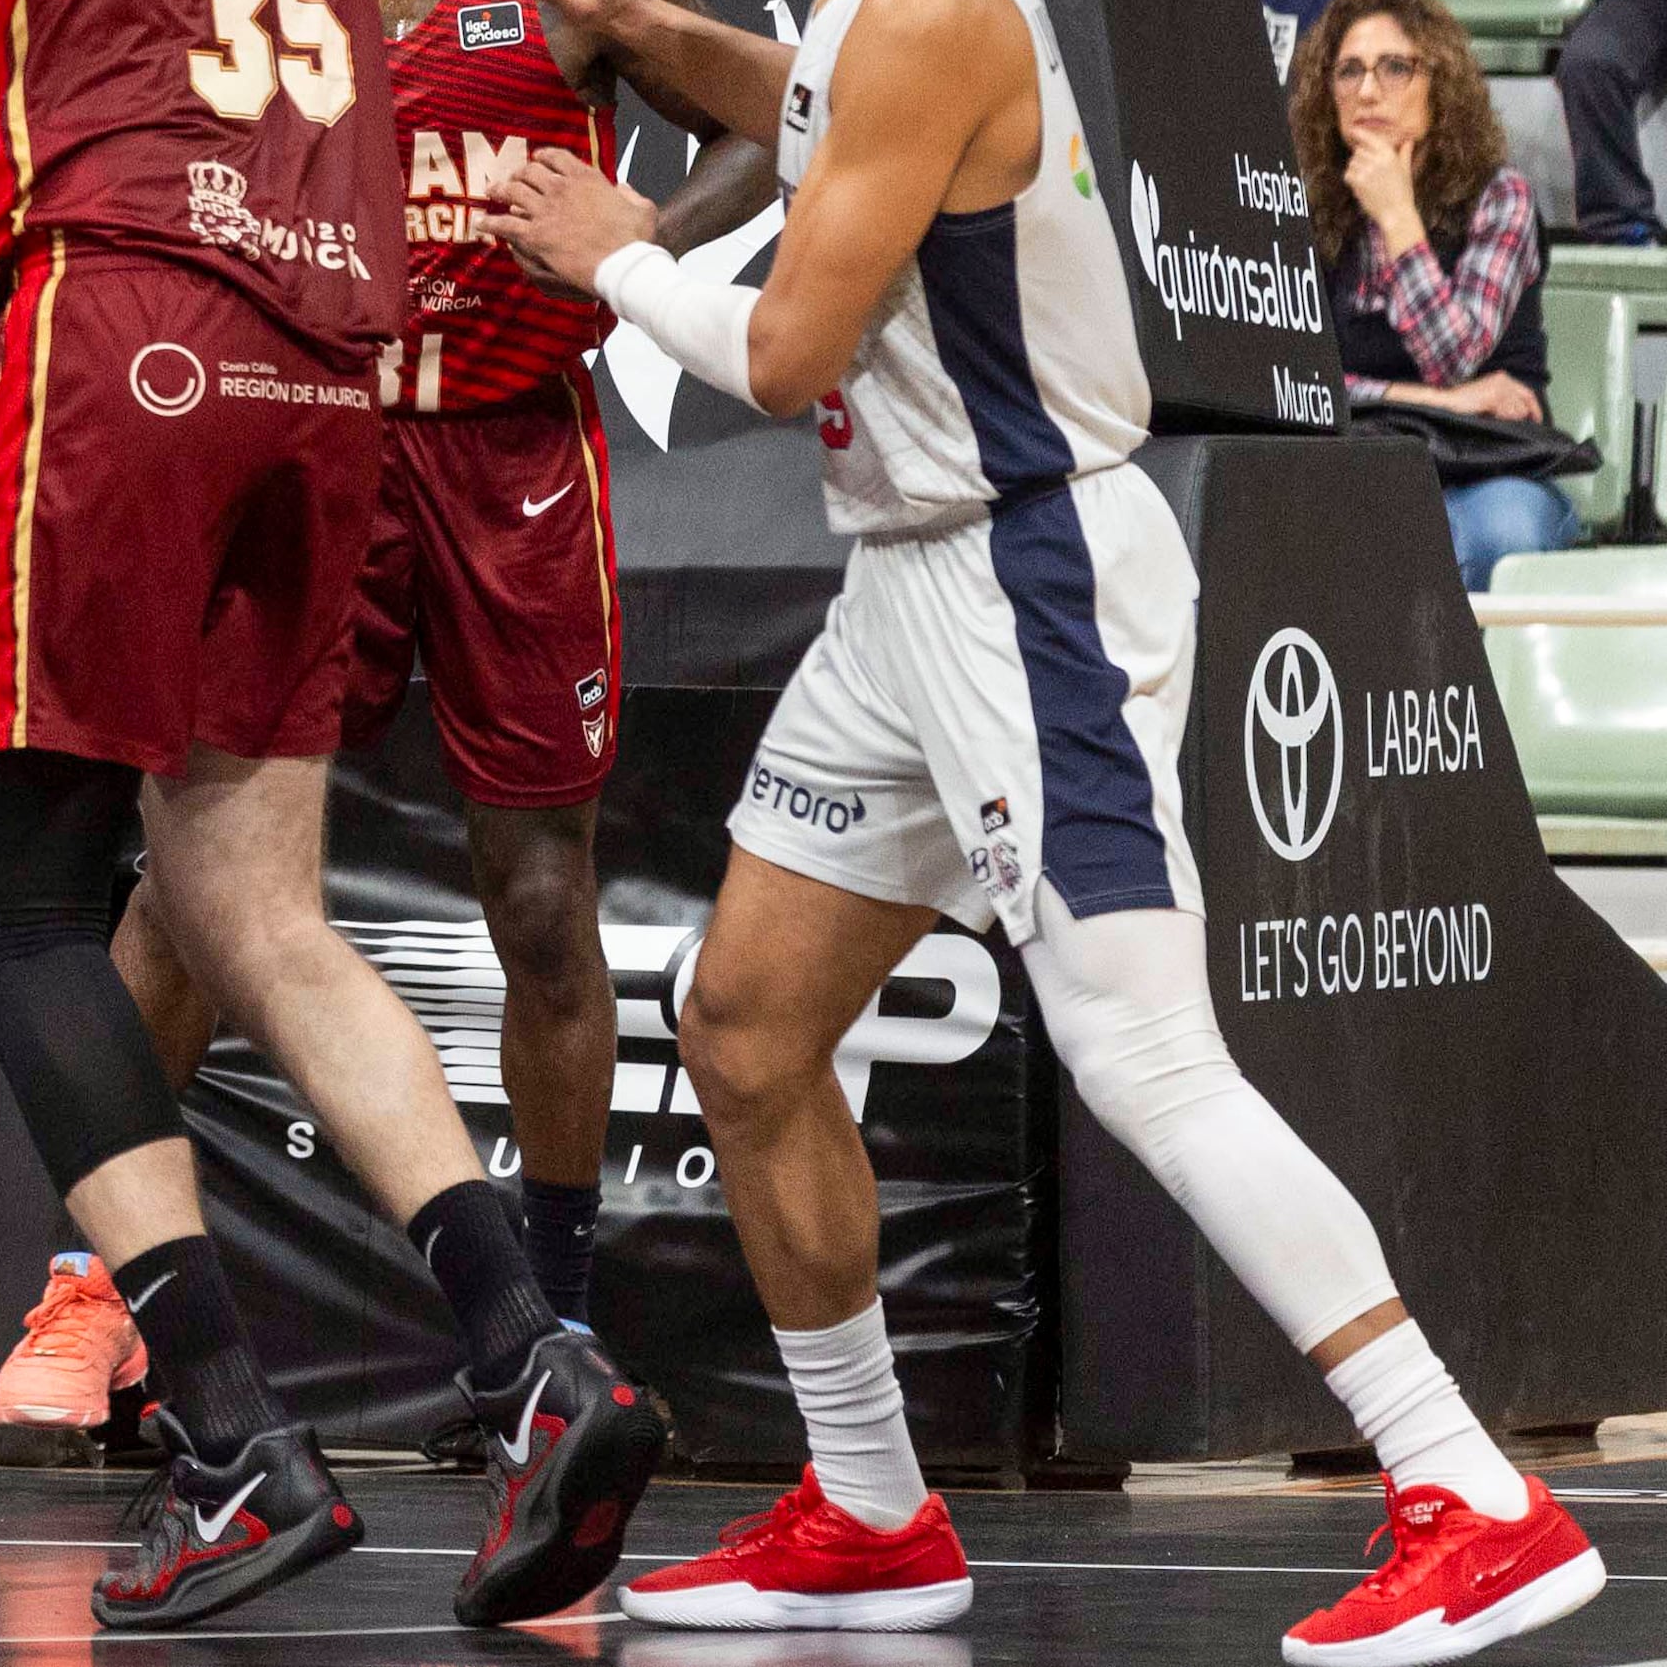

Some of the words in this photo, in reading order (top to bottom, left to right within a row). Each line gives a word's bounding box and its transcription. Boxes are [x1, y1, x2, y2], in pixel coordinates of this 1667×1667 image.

[1234, 153, 1310, 227] Hospital
[1156, 229, 1324, 342] quirónsalud
[220, 374, 290, 403] REGIÓN
[292, 384, 315, 404] DE
[316, 386, 371, 411] MURCIA
[1272, 365, 1335, 426] Murcia
[1366, 685, 1485, 780] LABASA
[1241, 912, 1310, 1005] LET'S
[1316, 908, 1368, 996] GO
[1371, 901, 1494, 993] BEYOND
